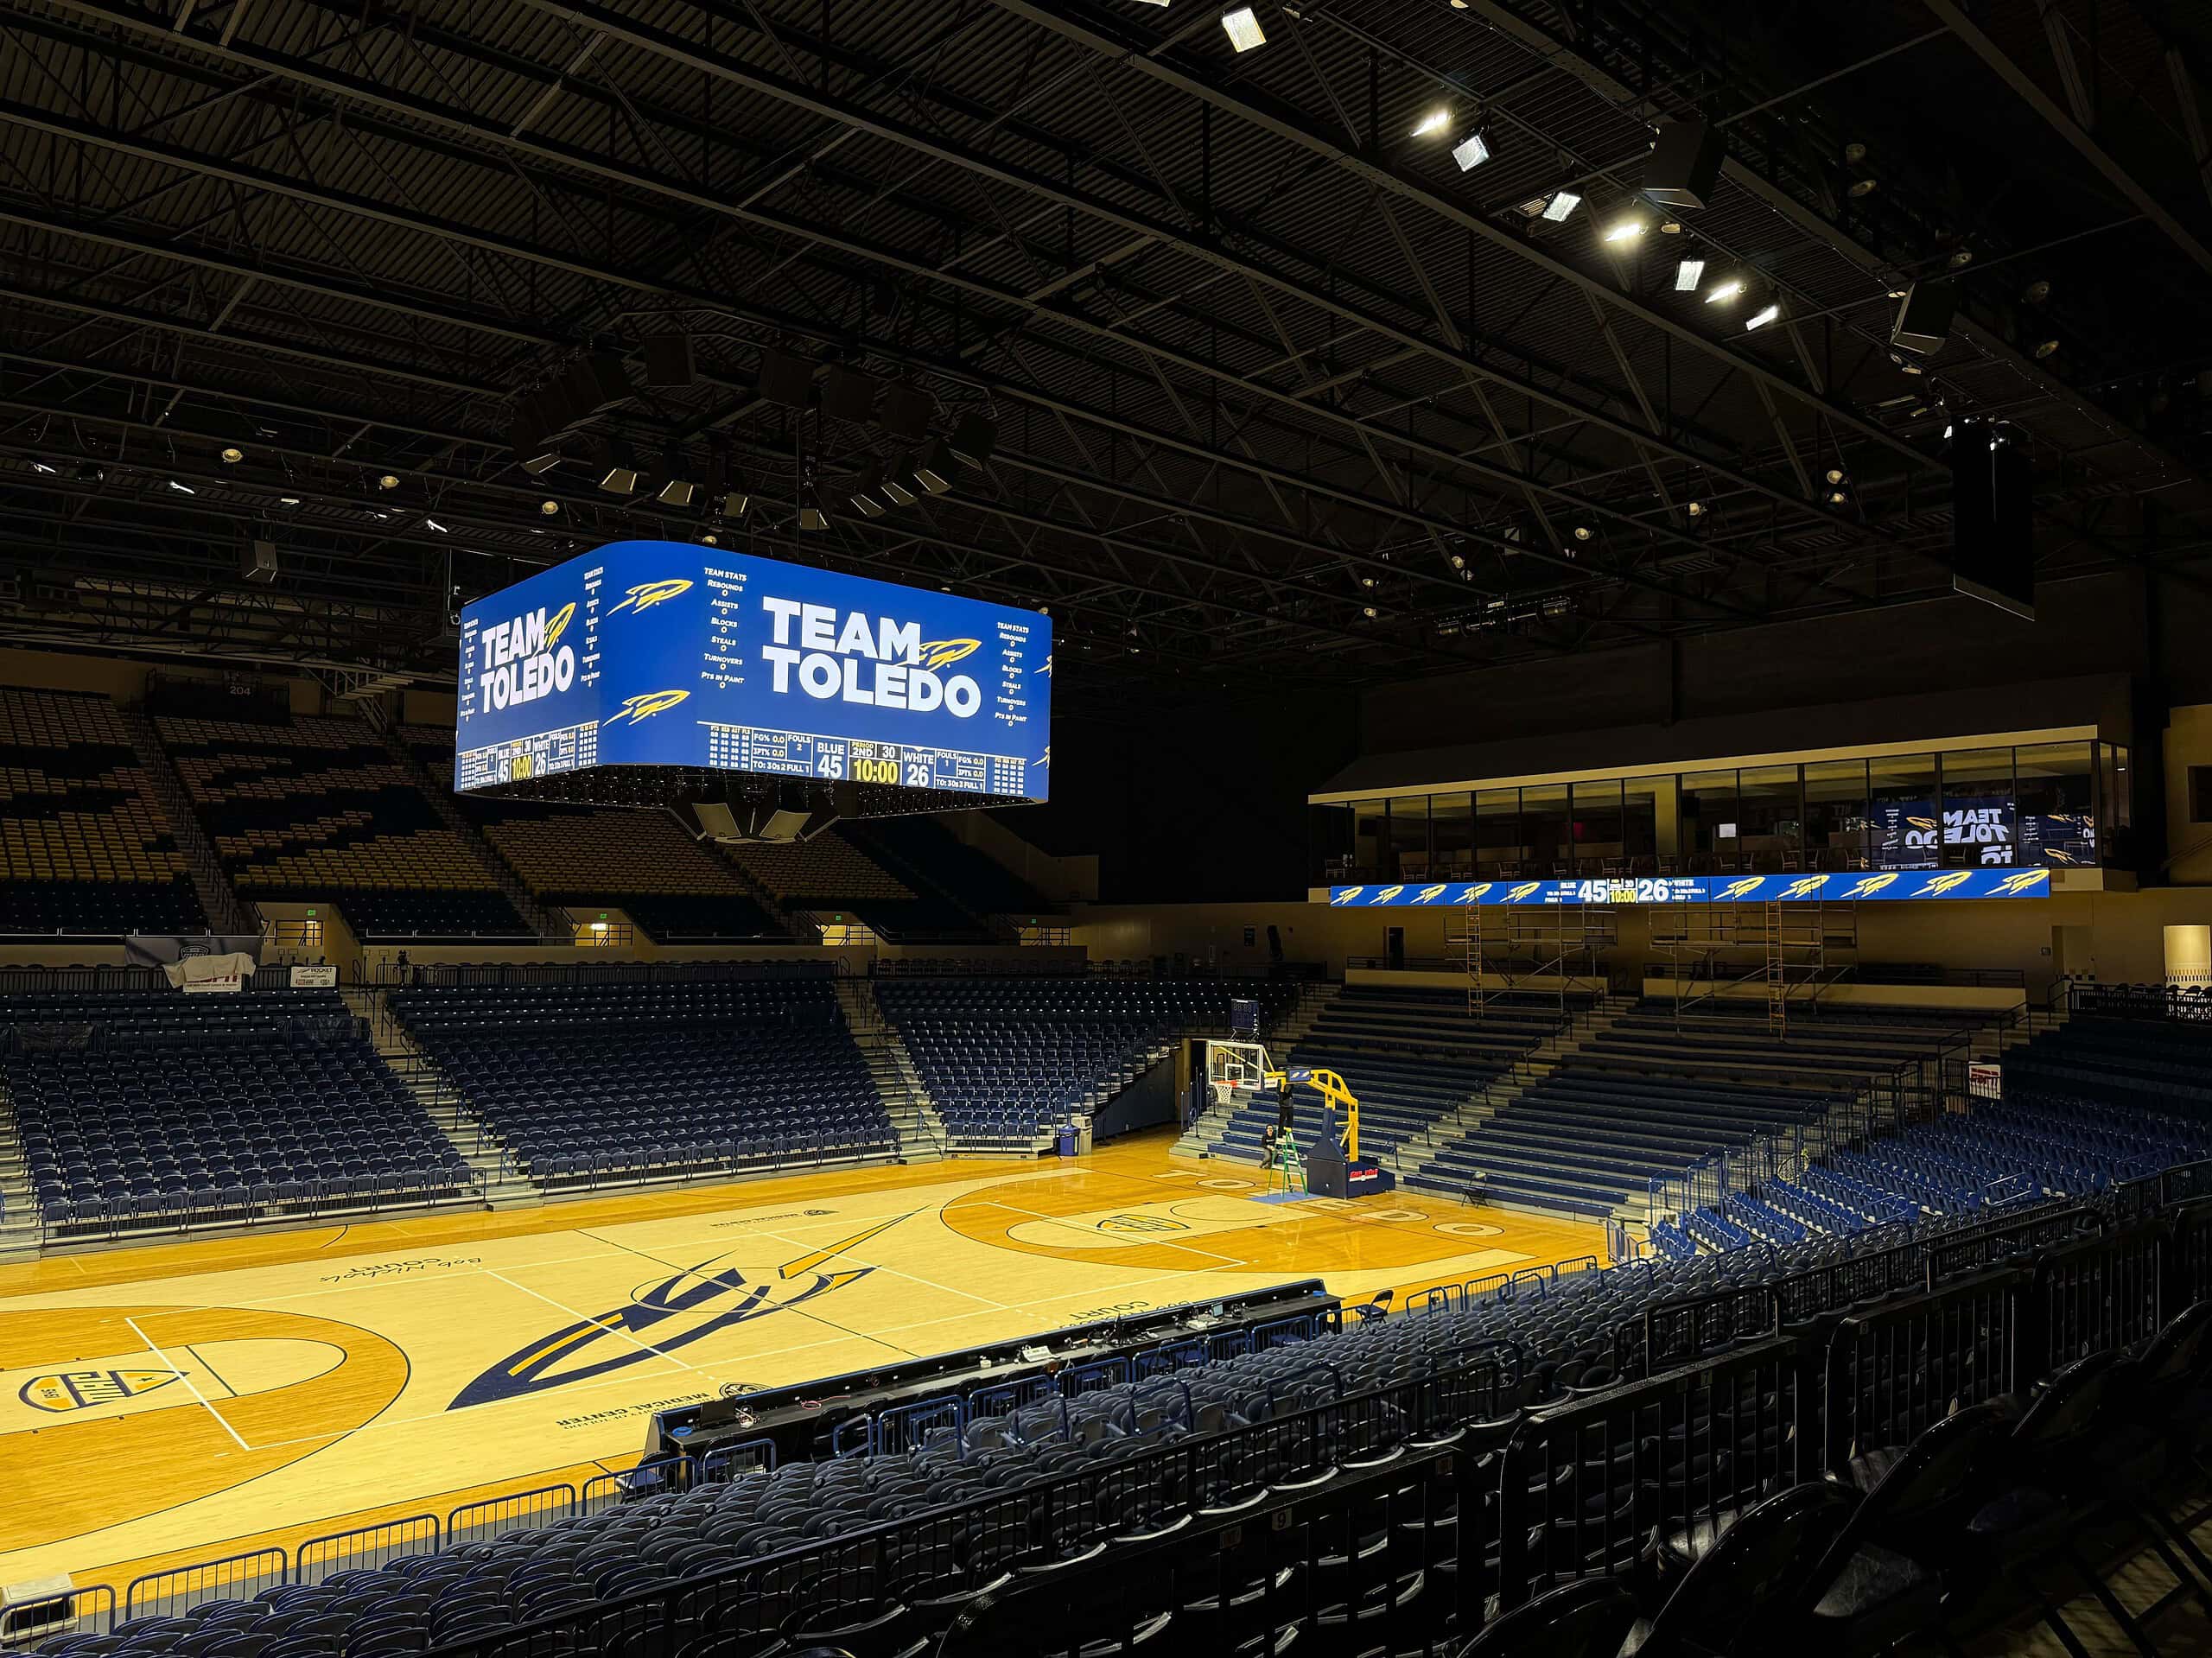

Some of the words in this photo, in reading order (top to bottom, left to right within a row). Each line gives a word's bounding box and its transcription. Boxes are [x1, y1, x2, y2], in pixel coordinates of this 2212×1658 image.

[704, 567, 724, 578] TEAM
[724, 571, 747, 581] STATS
[710, 617, 738, 628] BLOCKS
[763, 596, 920, 665] TEAM
[482, 607, 545, 670] TEAM
[711, 635, 736, 646] STEALS
[704, 652, 743, 665] TURNOVERS
[480, 645, 575, 714] TOLEDO
[724, 674, 745, 684] PAINT
[762, 645, 982, 719] TOLEDO
[753, 734, 770, 742] FG%
[788, 734, 811, 743] FOULS
[817, 741, 844, 755] BLUE
[853, 746, 873, 757] 2ND
[882, 746, 896, 759] 30
[937, 752, 957, 760] FOULS
[512, 754, 532, 780] 10:00
[535, 752, 546, 775] 26
[817, 754, 842, 778] 45
[904, 752, 934, 765] WHITE
[498, 759, 509, 782] 45
[854, 759, 898, 784] 10:00
[906, 764, 929, 788] 26
[1578, 880, 1607, 903] 45
[1610, 890, 1636, 903] 10:00
[1638, 879, 1669, 902] 26
[1069, 1300, 1150, 1321] COURT
[629, 1393, 710, 1410] MEDICAL
[556, 1408, 629, 1426] CENTER
